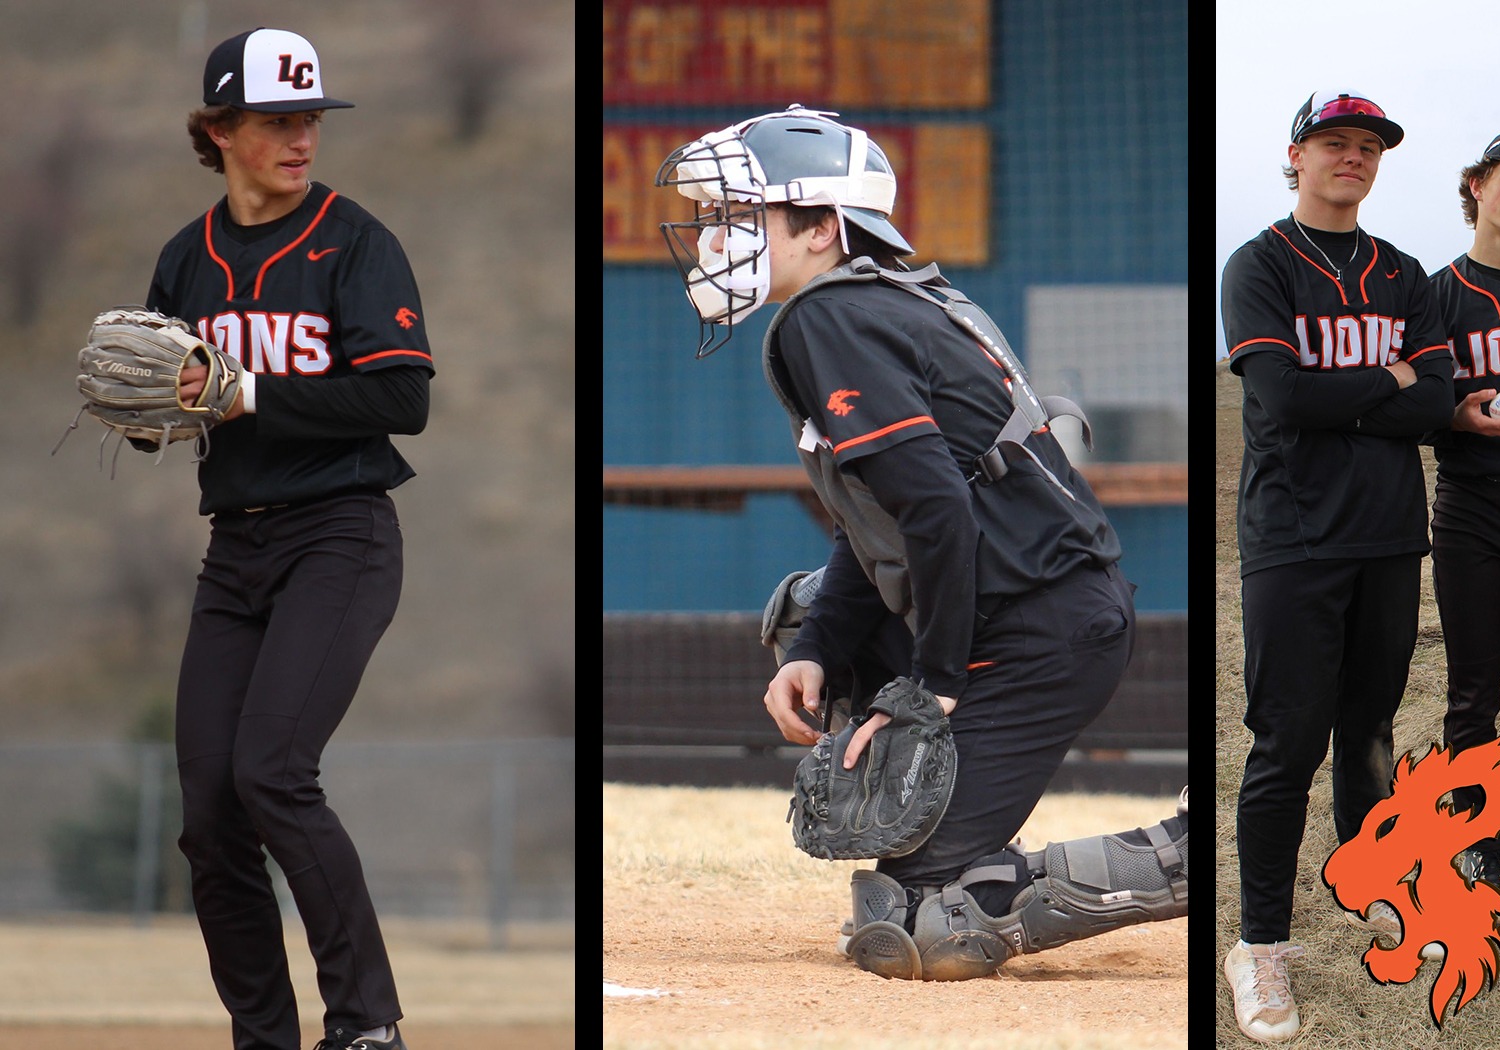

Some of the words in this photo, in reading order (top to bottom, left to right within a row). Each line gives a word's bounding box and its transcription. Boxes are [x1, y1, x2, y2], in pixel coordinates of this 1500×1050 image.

[278, 54, 313, 90] LC
[197, 311, 333, 376] ONS
[1295, 313, 1405, 369] LIONS
